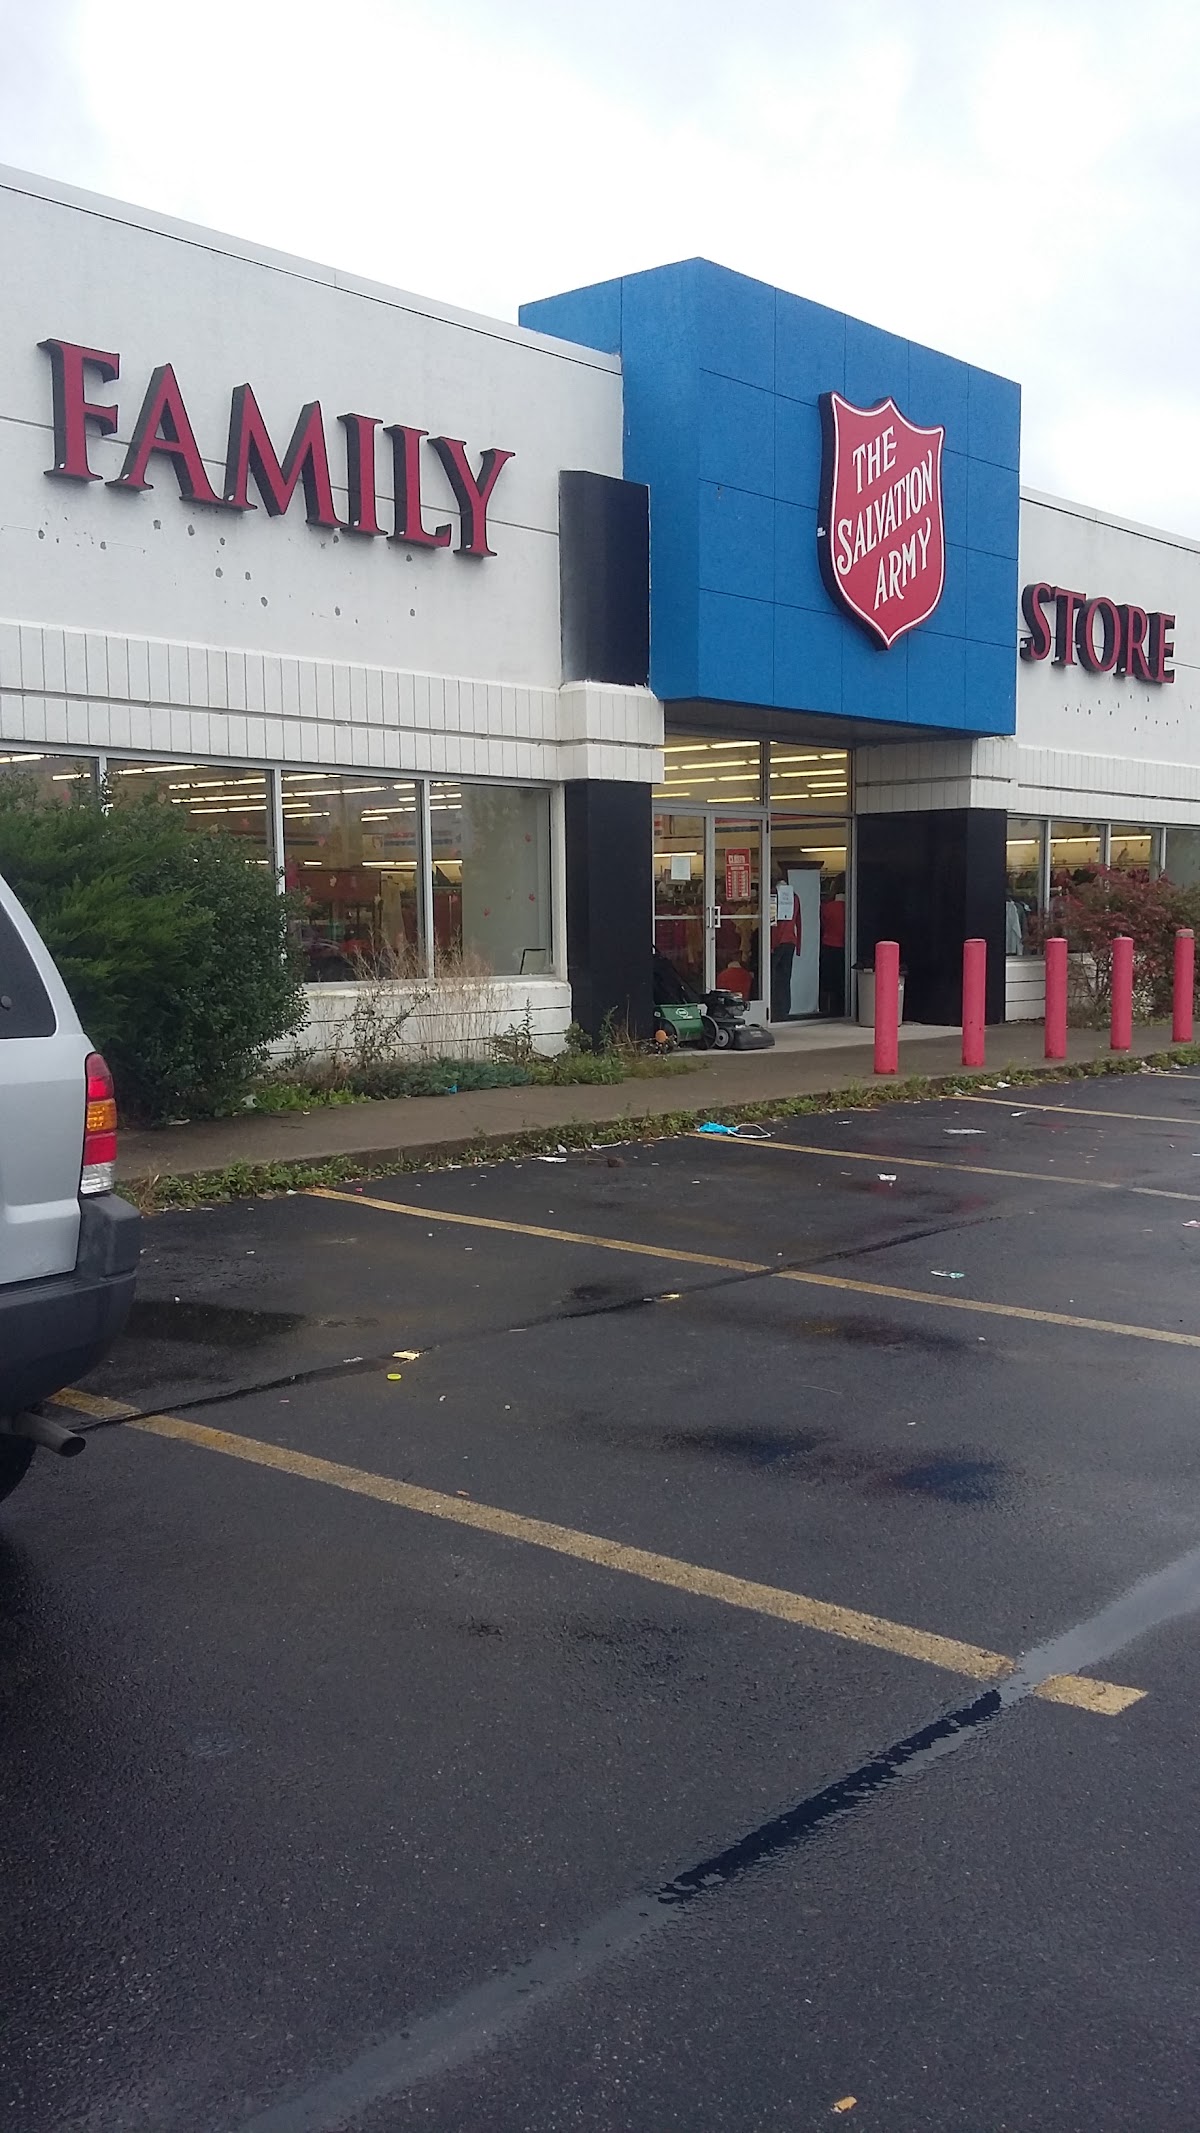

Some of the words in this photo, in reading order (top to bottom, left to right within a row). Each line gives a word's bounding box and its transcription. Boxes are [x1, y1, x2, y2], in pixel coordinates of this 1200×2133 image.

[36, 338, 516, 558] FAMILY
[852, 425, 897, 494] THE
[837, 449, 933, 576] SALVATION
[874, 516, 931, 611] ARMY
[1019, 582, 1176, 684] STORE
